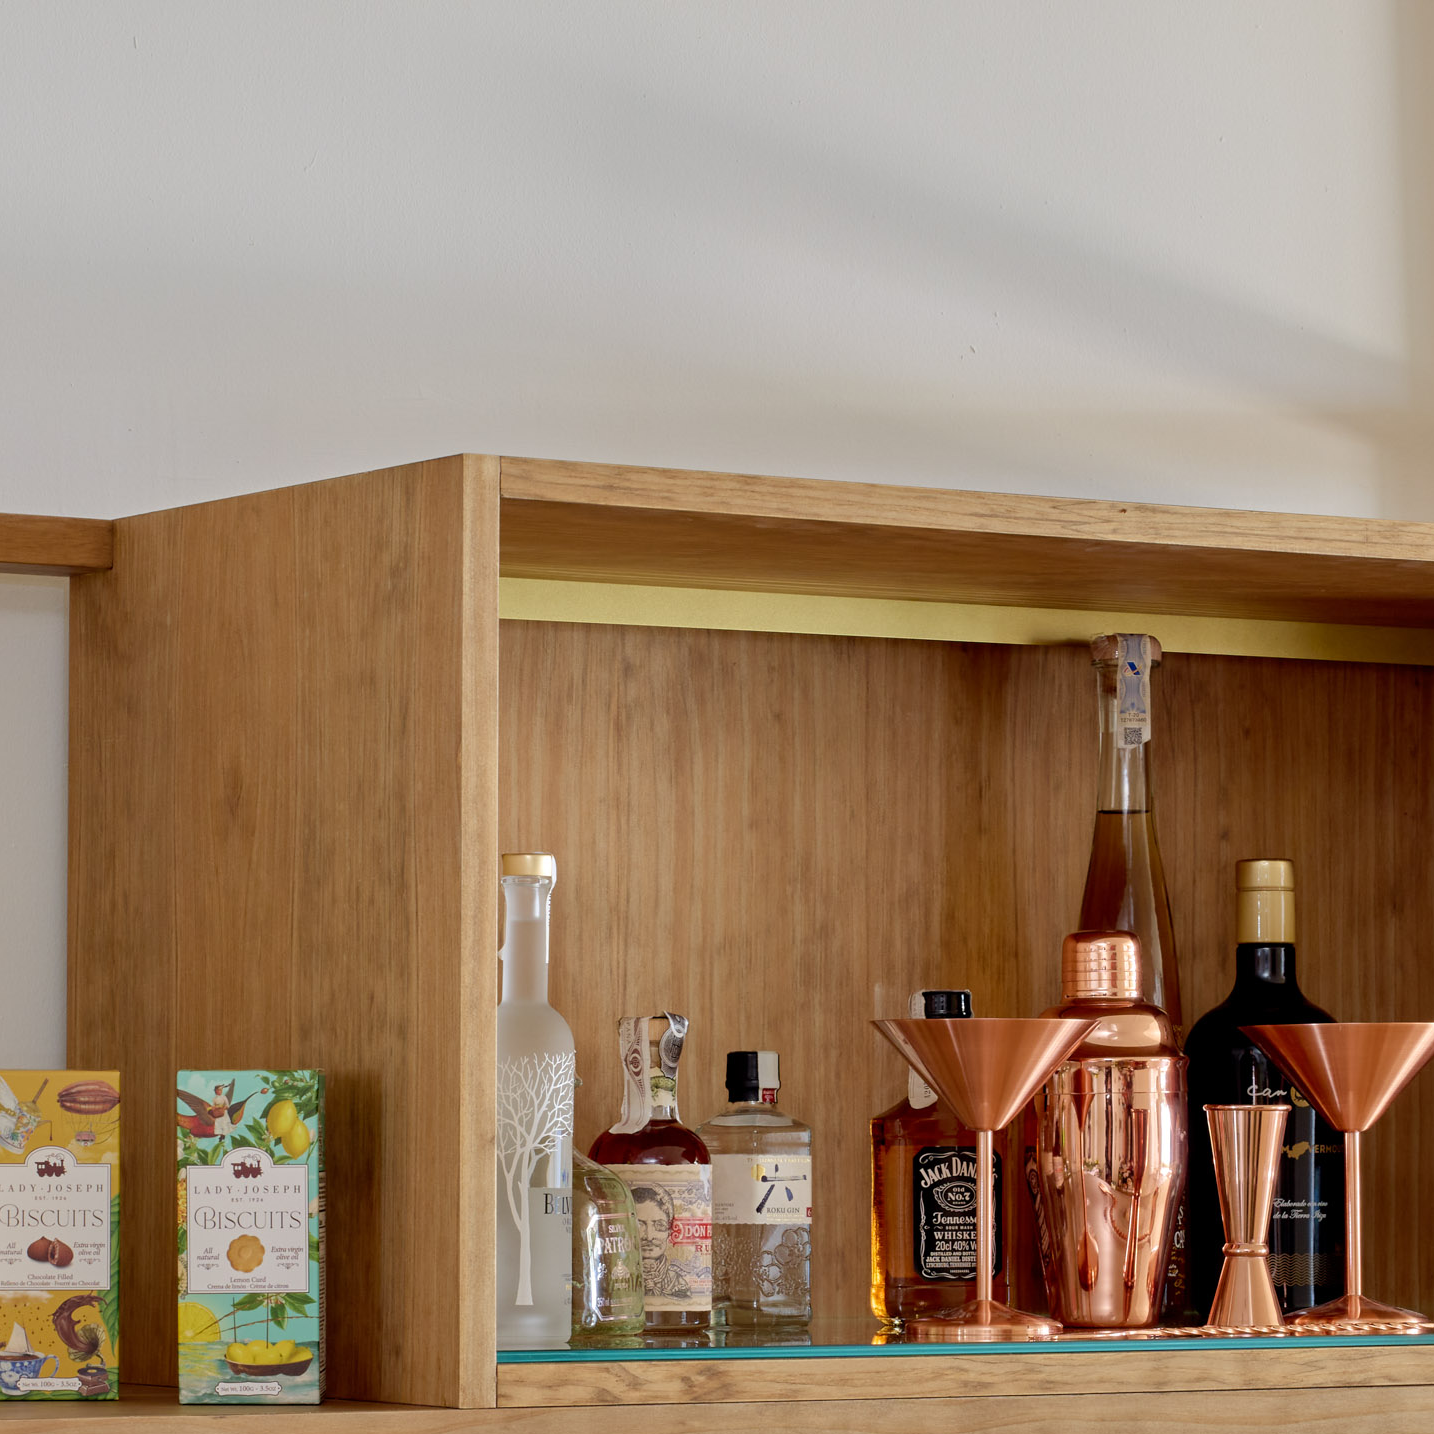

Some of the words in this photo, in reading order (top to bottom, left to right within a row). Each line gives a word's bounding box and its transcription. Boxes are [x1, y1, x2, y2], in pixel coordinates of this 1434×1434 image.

[1247, 1084, 1287, 1098] Can
[919, 1162, 952, 1188] JACK
[47, 1184, 104, 1193] JOSEPH
[194, 1186, 233, 1194] LADY
[244, 1185, 301, 1194] JOSEPH
[1273, 1198, 1307, 1207] Elaborado
[932, 1212, 976, 1224] Tenness
[1282, 1211, 1288, 1219] la
[1289, 1209, 1310, 1219] Tierra
[685, 1225, 704, 1237] DON
[933, 1231, 976, 1240] WHISKE
[90, 1242, 106, 1251] virgin
[287, 1246, 304, 1255] virgin
[935, 1241, 951, 1251] 20cl
[953, 1241, 969, 1250] 40%
